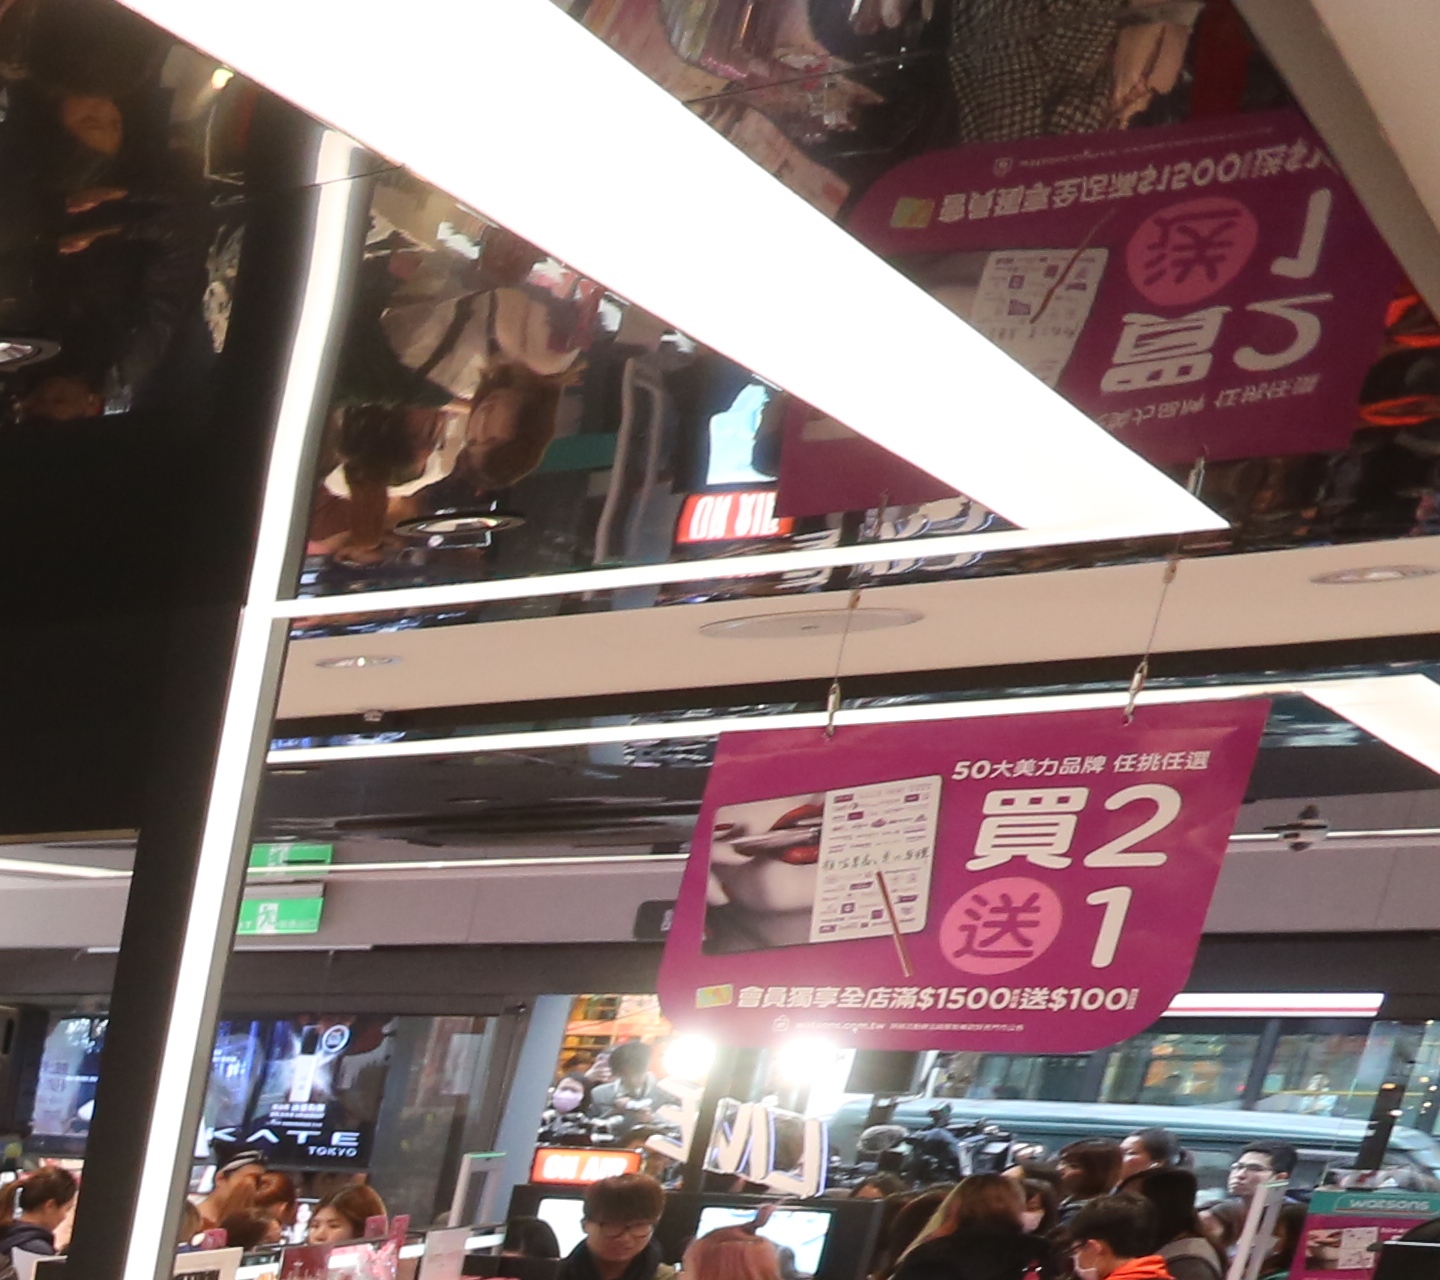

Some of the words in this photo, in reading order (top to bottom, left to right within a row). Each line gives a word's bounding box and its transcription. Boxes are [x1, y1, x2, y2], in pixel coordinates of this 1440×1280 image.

[953, 753, 1104, 779] 50大美力品牌
[1114, 750, 1210, 774] 任挑任選
[204, 1128, 360, 1148] KATE
[307, 1145, 358, 1158] TOKYO
